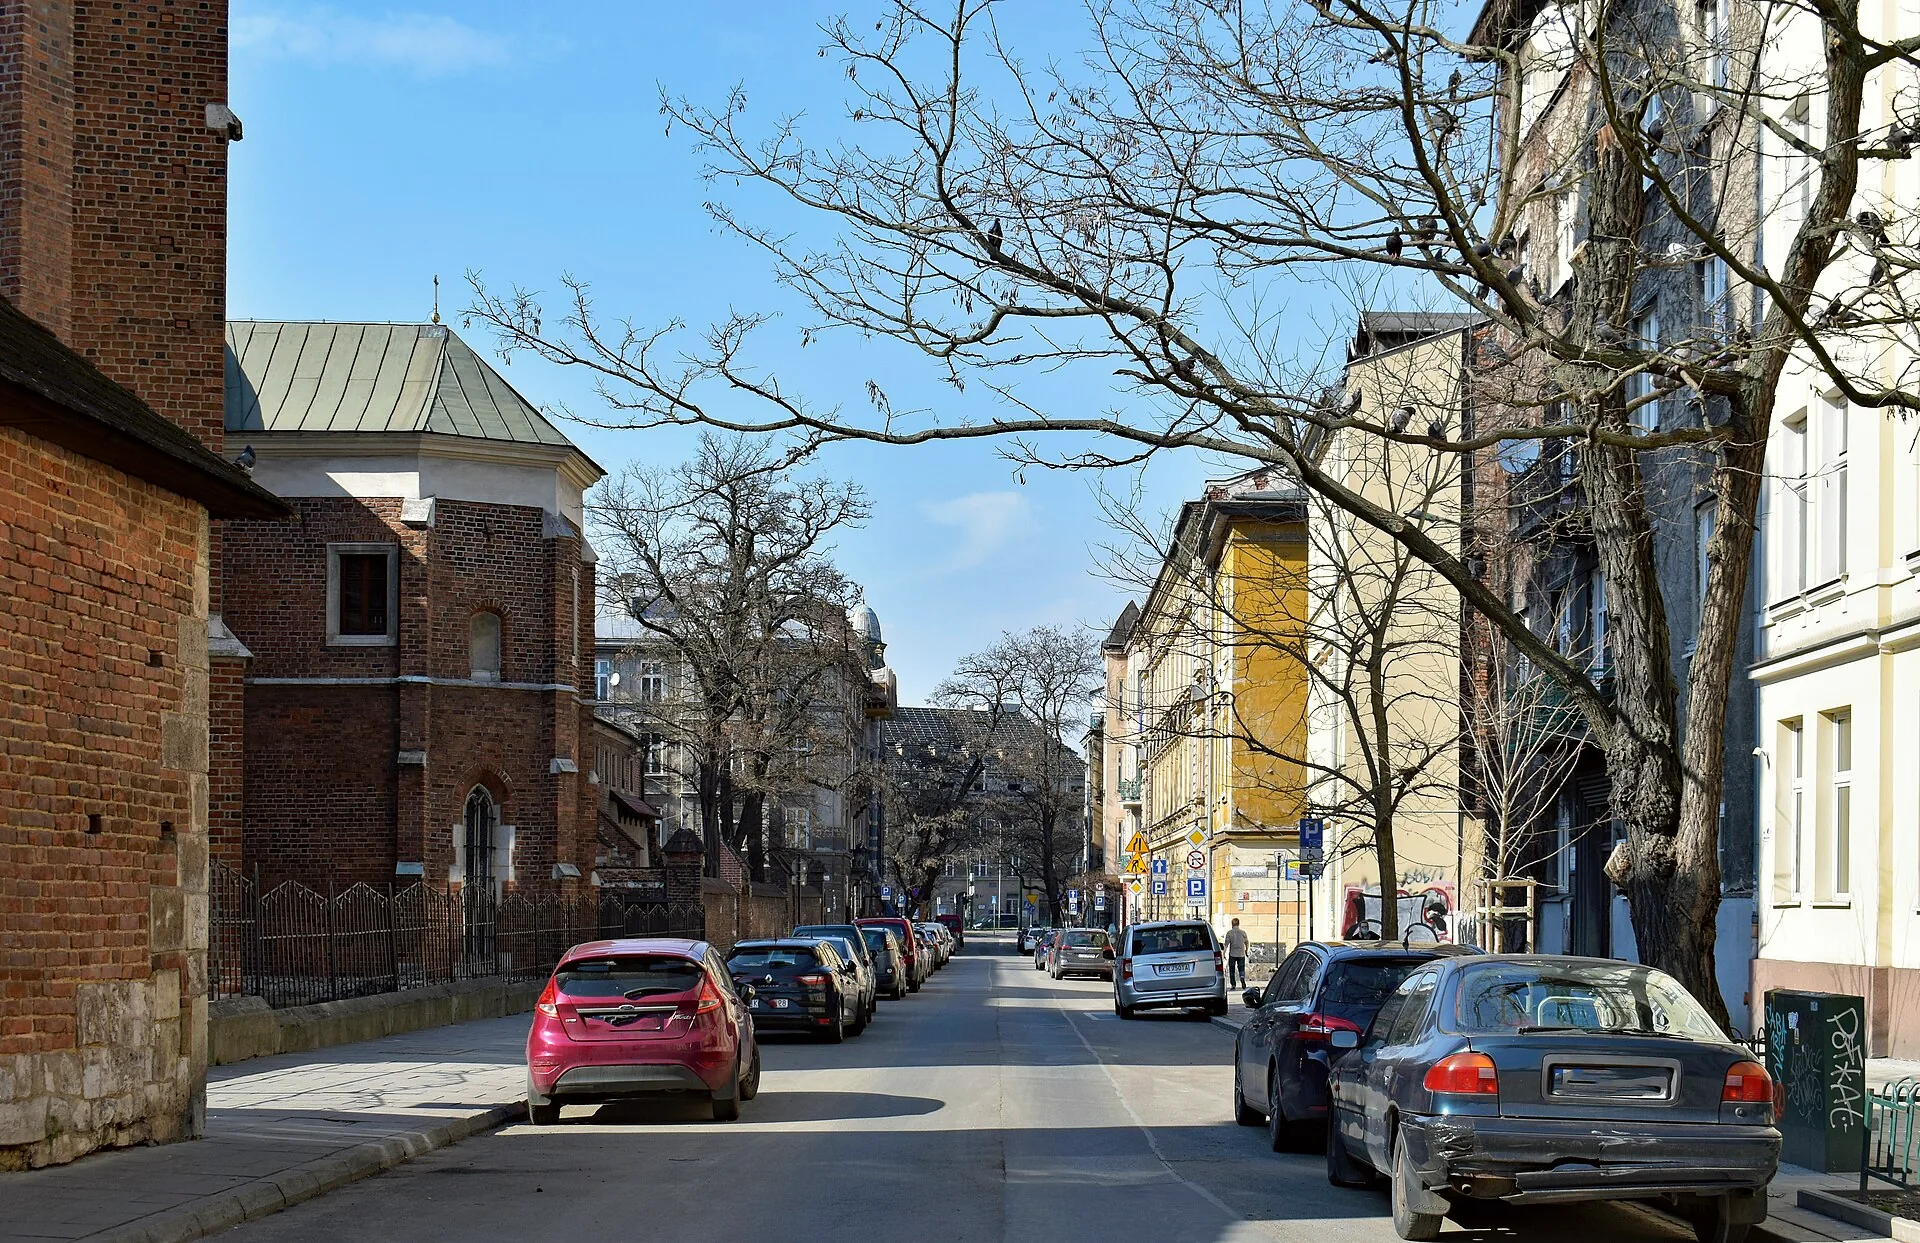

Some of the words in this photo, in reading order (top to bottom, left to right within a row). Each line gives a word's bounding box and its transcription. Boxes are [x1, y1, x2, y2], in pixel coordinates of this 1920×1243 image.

[1305, 820, 1319, 839] P
[1154, 882, 1163, 893] P
[1190, 880, 1202, 895] P
